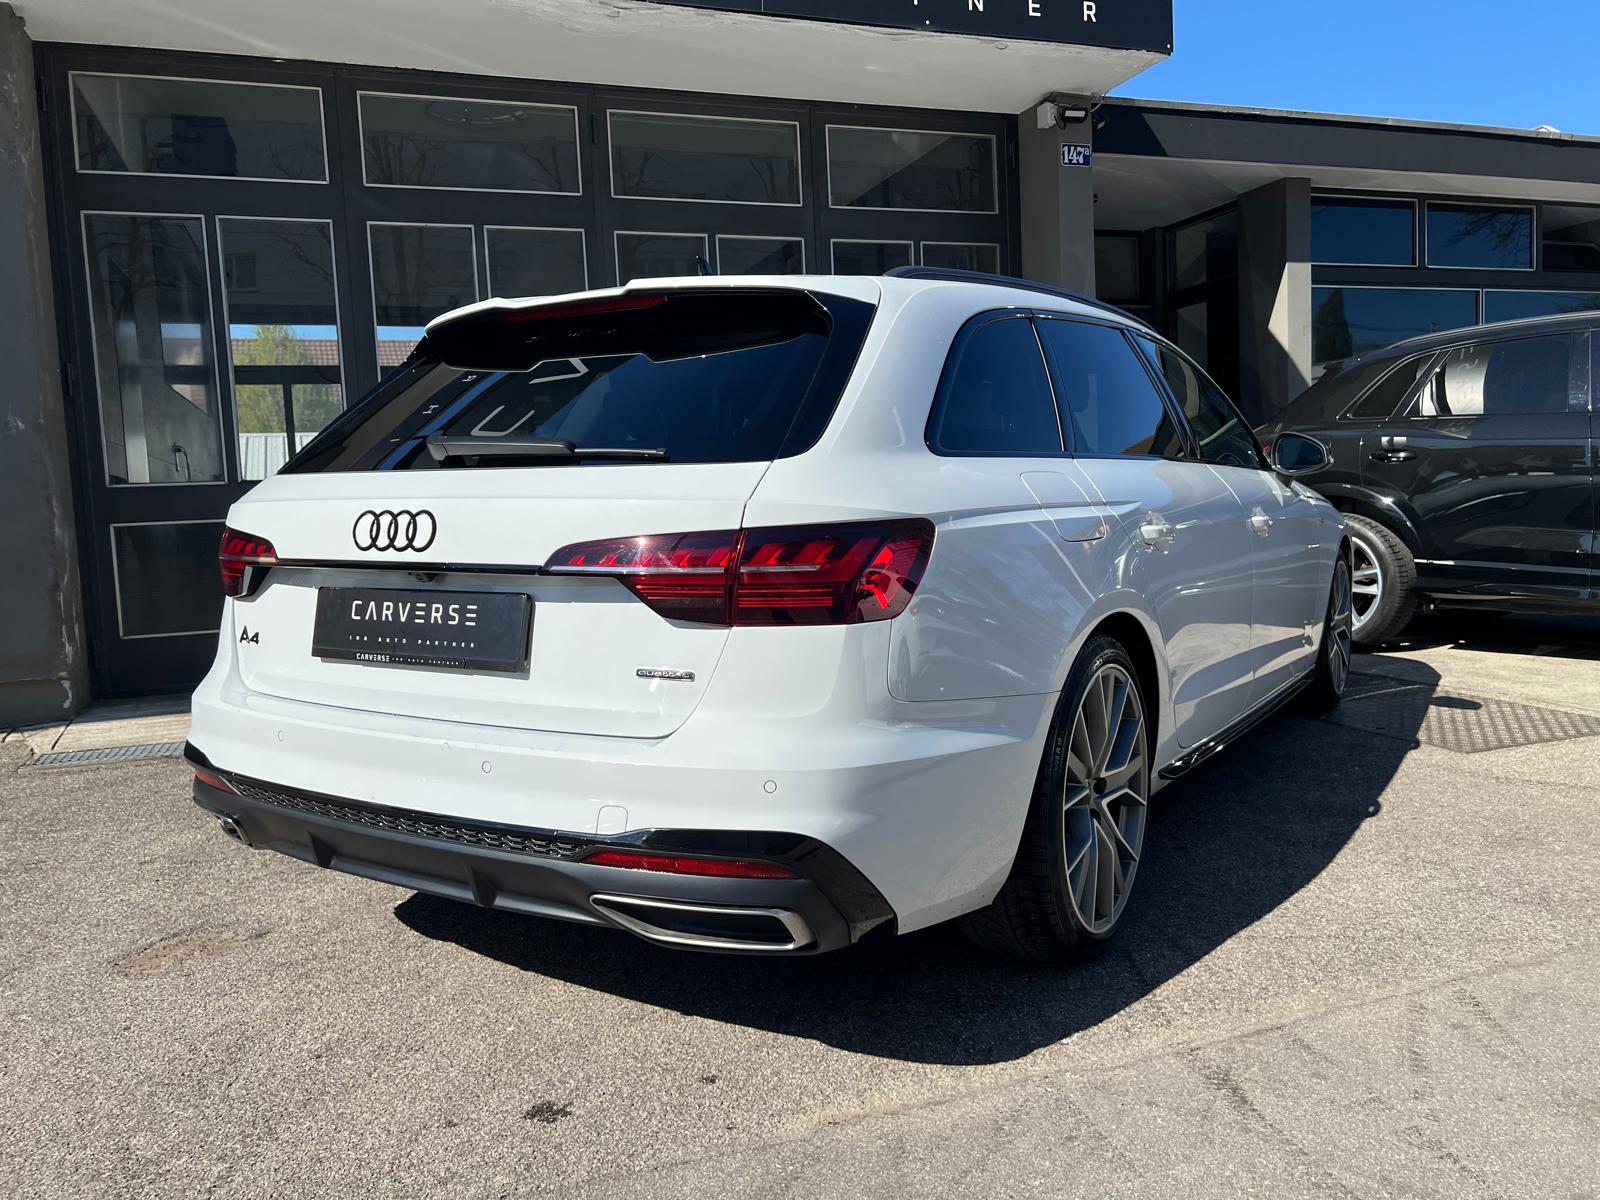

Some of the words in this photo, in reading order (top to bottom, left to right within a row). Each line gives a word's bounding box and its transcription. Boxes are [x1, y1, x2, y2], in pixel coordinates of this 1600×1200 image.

[912, 0, 1097, 23] NER
[351, 600, 478, 626] CARVERSE
[239, 625, 260, 645] A4
[356, 652, 390, 662] CARVERSE
